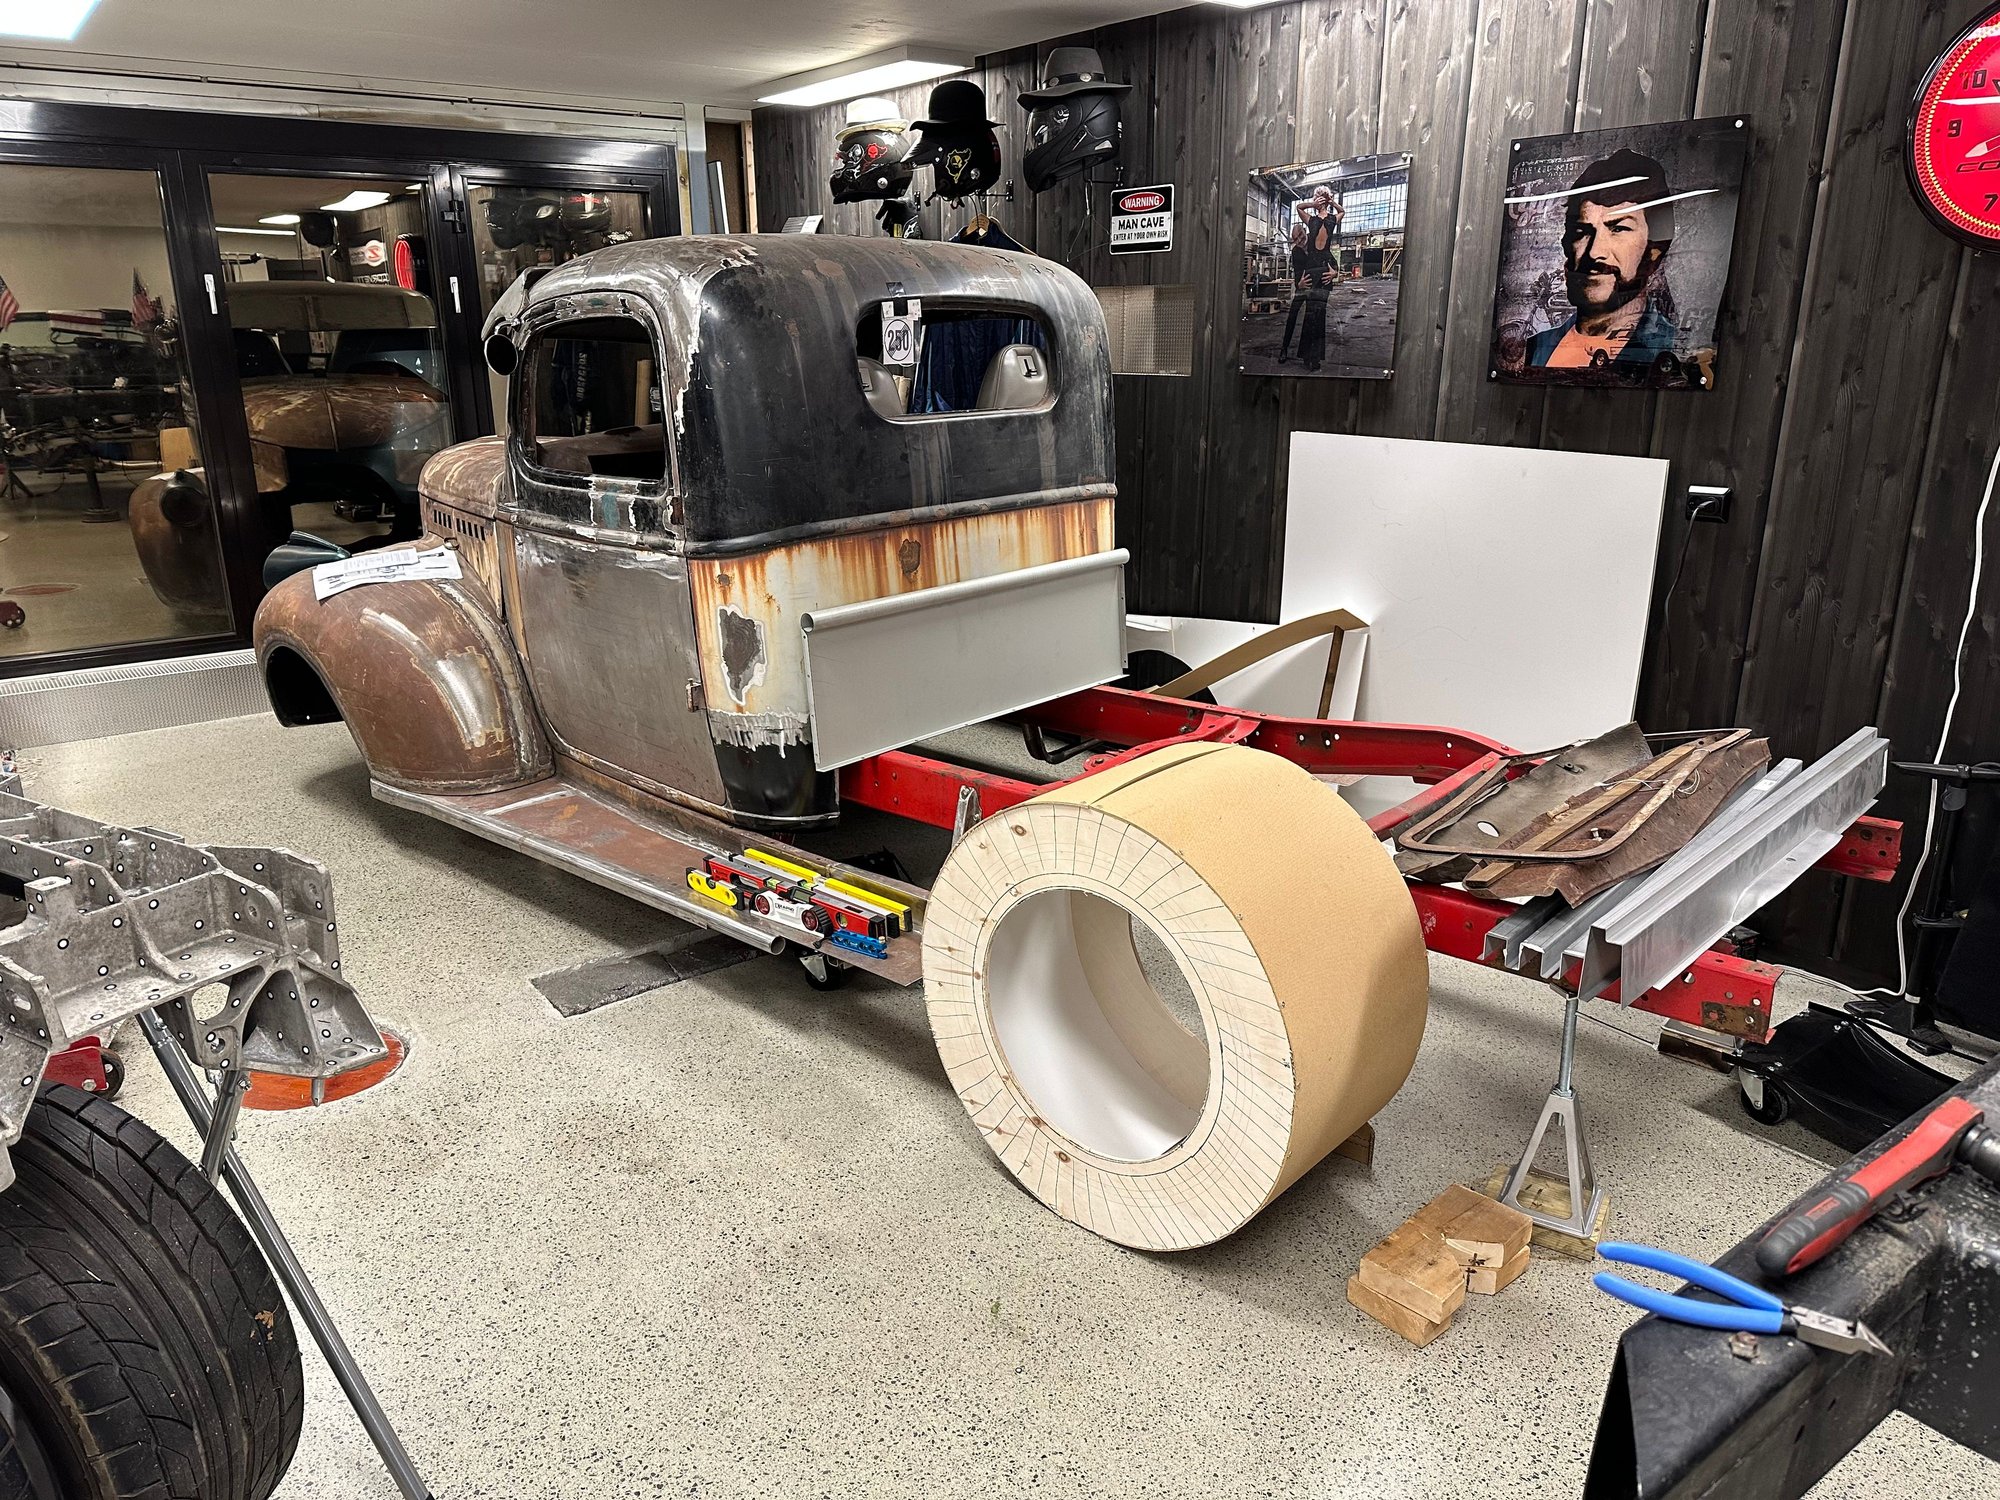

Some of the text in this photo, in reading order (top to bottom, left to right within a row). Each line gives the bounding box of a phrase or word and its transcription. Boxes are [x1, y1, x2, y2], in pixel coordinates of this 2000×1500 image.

[1960, 69, 1987, 90] 10
[1947, 118, 1963, 138] 9
[1124, 196, 1160, 208] WARNING
[1984, 193, 1999, 212] 7
[1118, 216, 1164, 230] MAN CAVE
[1113, 230, 1168, 241] ENTER AT YOUR OWN RISK
[887, 329, 909, 351] 250
